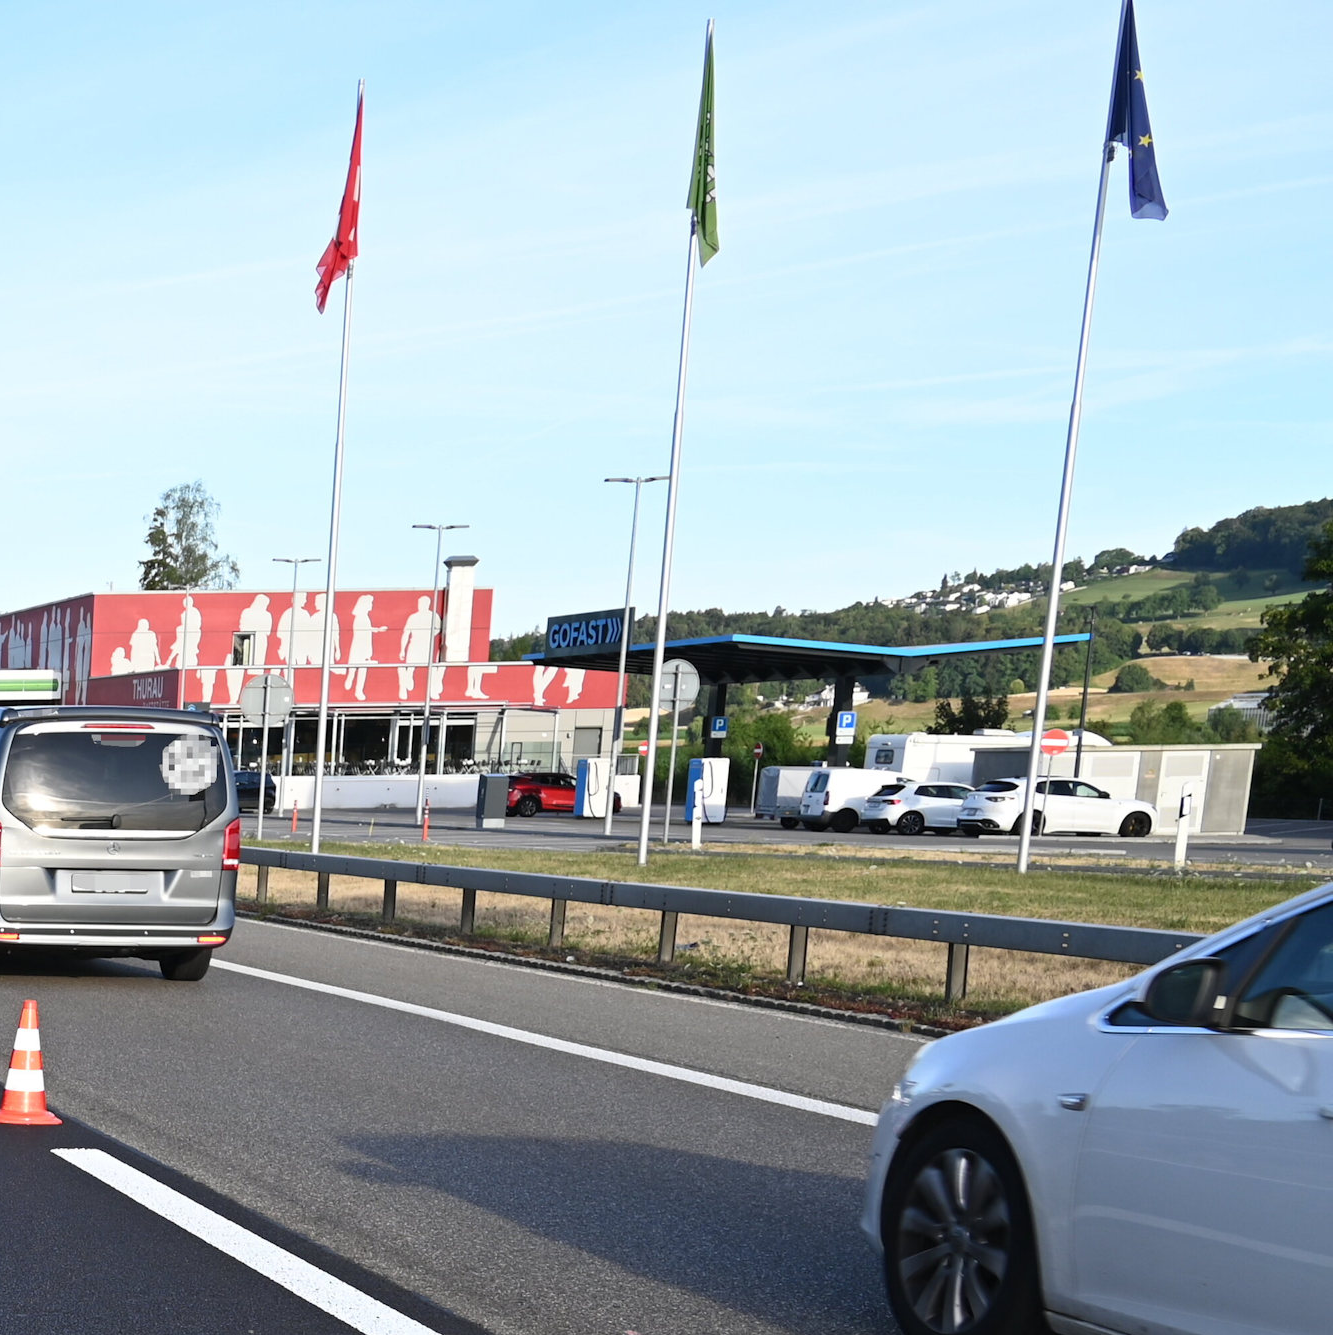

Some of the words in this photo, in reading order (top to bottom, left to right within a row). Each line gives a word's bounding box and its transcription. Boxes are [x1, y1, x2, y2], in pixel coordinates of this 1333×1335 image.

[549, 619, 606, 649] GOFAST
[133, 676, 164, 700] THURAU
[715, 718, 724, 730] P
[842, 714, 852, 728] P
